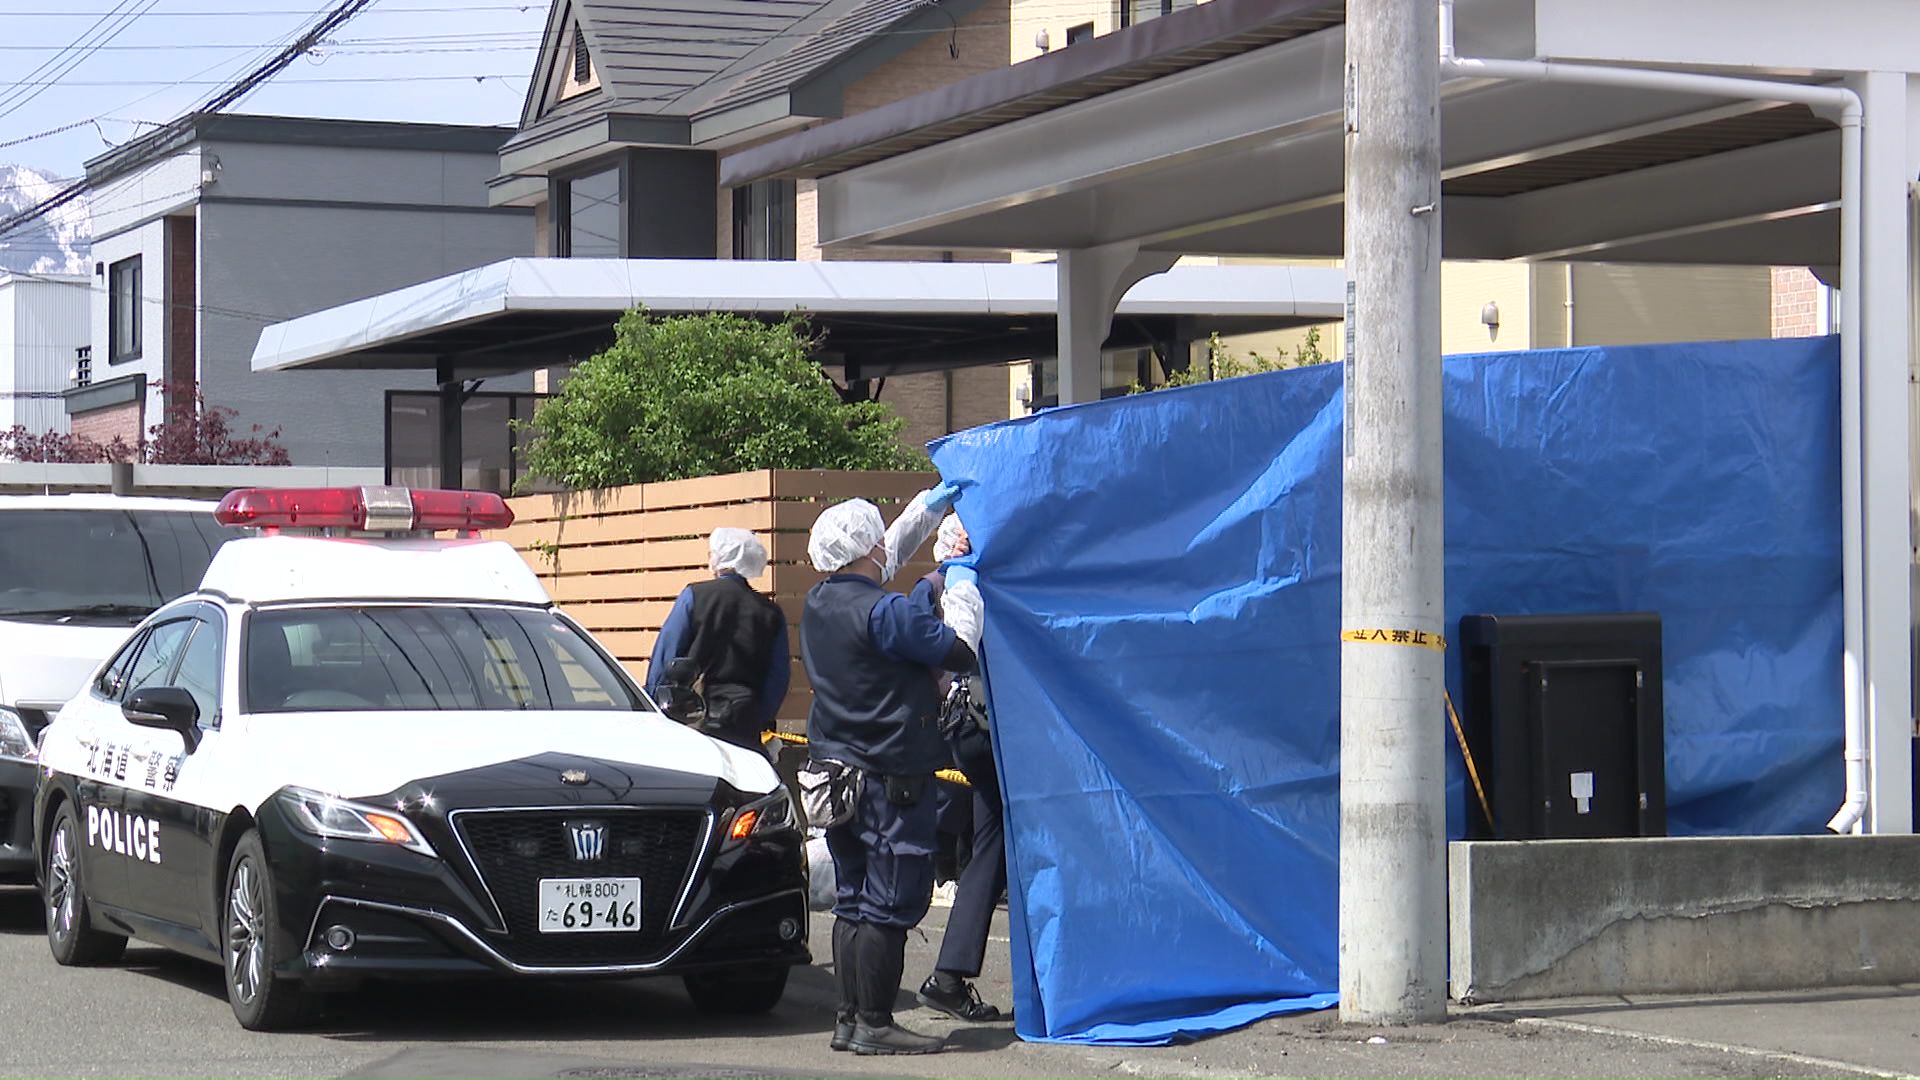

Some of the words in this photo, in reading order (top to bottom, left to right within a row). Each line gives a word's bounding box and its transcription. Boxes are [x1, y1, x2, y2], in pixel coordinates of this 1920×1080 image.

[88, 804, 161, 864] POLICE
[545, 908, 558, 921] た
[563, 901, 635, 928] 69-46
